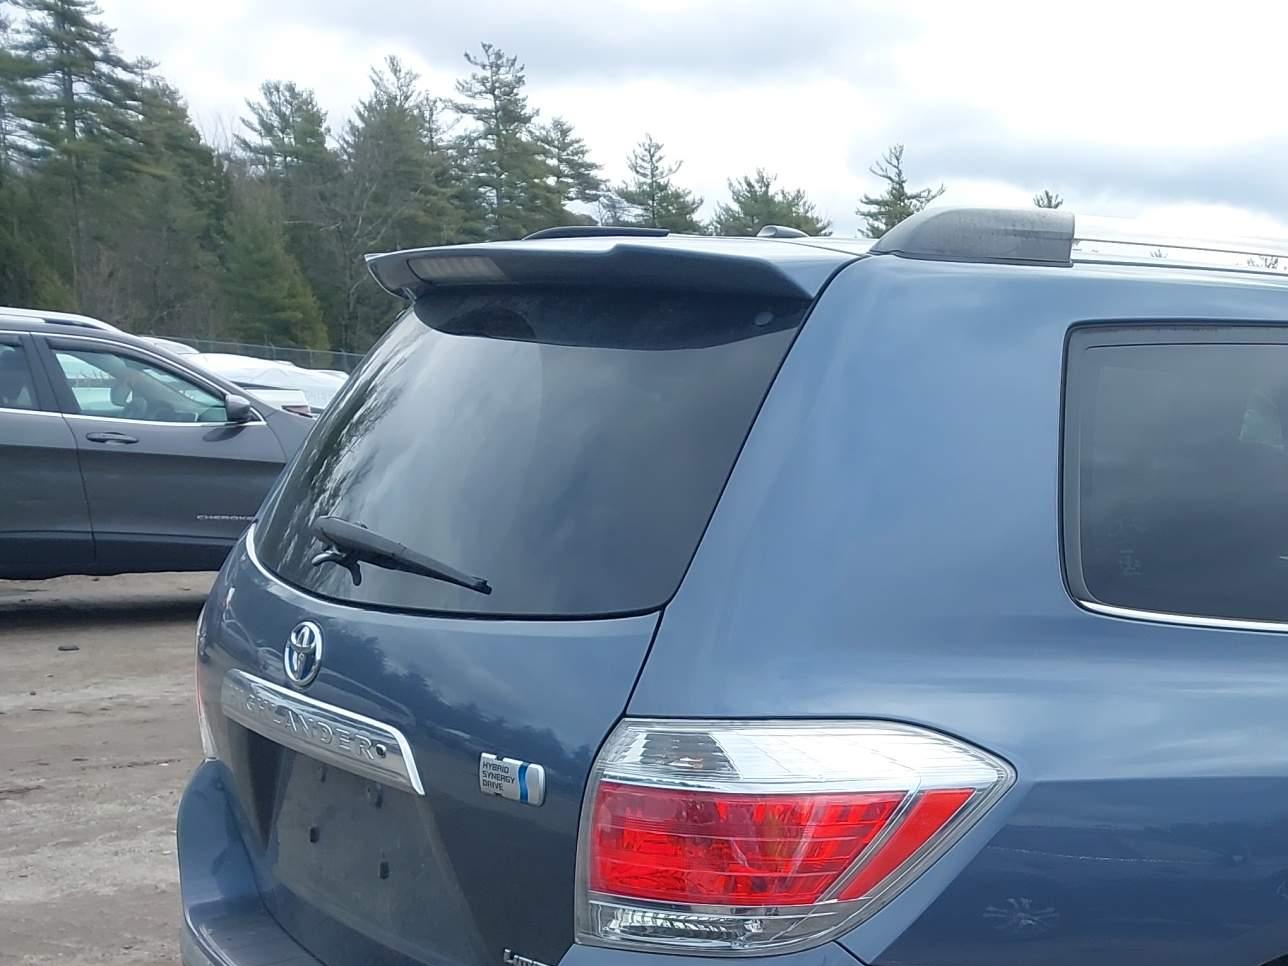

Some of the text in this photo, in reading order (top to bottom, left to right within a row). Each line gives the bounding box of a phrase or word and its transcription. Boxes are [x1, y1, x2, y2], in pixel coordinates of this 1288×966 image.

[482, 761, 510, 774] HYBRID
[482, 770, 516, 785] SYNERGY
[482, 779, 504, 791] DRIVE
